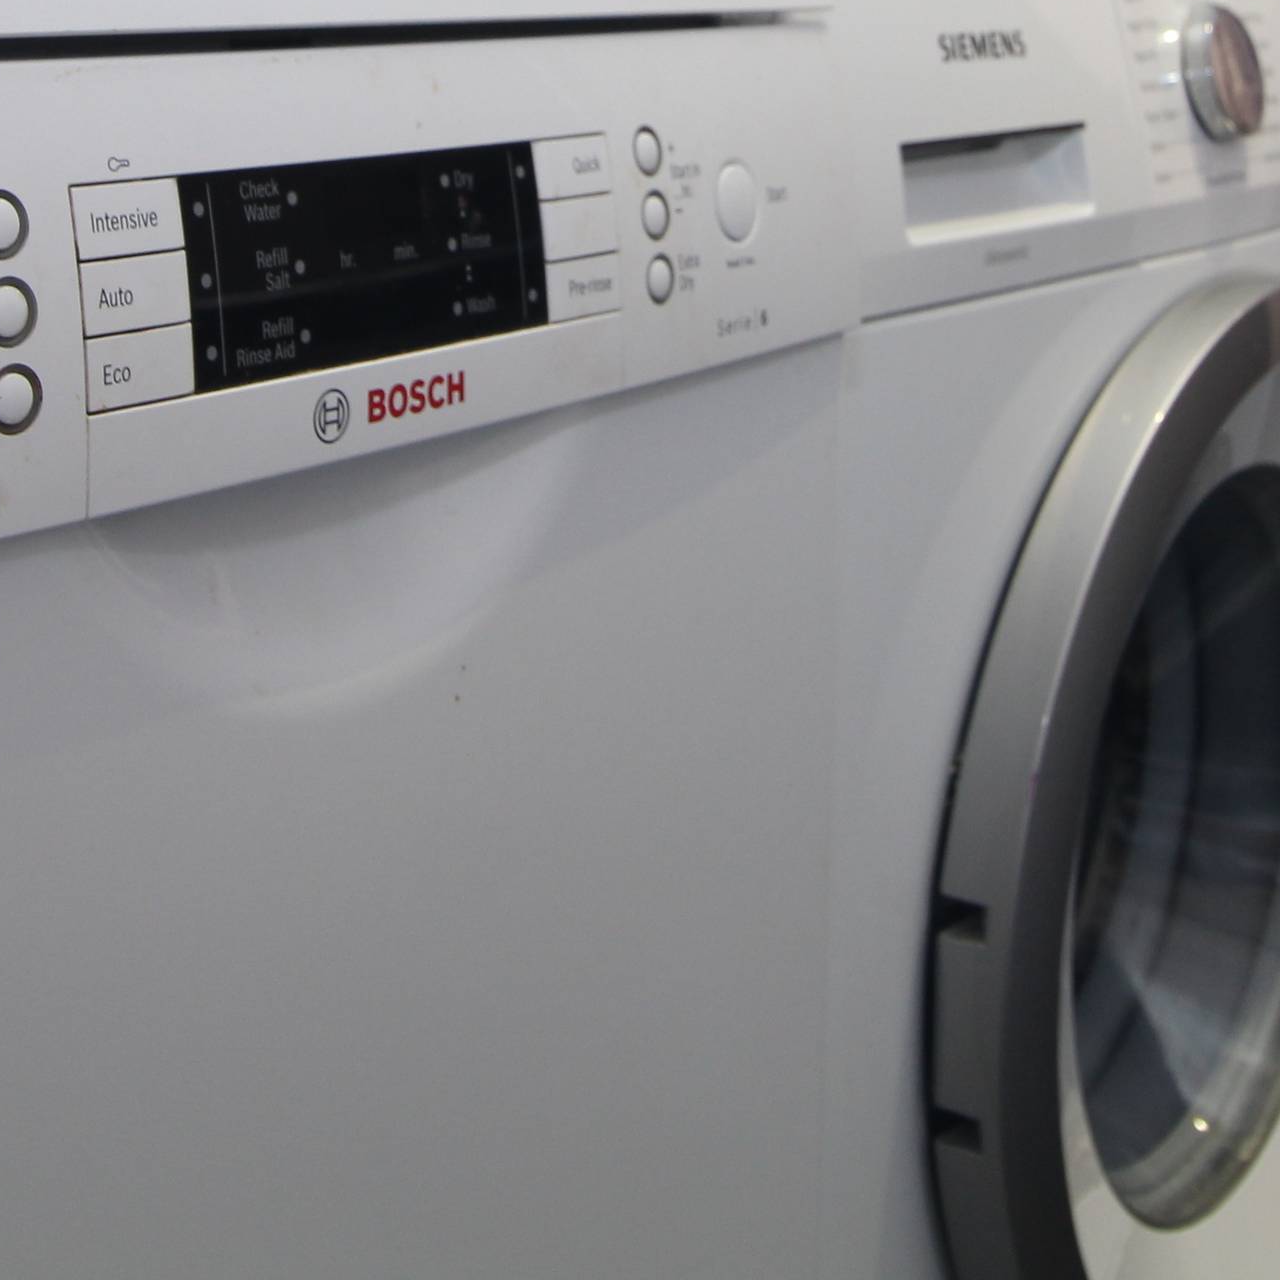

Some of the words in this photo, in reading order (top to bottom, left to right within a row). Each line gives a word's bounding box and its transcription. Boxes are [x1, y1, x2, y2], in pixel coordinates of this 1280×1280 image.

[938, 29, 1026, 62] SIEMENS
[572, 156, 601, 175] Quick
[239, 178, 280, 200] Check
[453, 170, 474, 192] Dry
[90, 208, 159, 234] Intensive
[244, 203, 282, 222] Water
[256, 247, 289, 269] Refill
[393, 241, 418, 261] min.
[265, 272, 291, 292] Salt
[98, 285, 135, 310] Auto
[465, 295, 496, 313] Wash
[262, 317, 295, 339] Refill
[236, 347, 272, 369] Rinse
[274, 340, 296, 361] Aid
[102, 363, 133, 387] Eco
[367, 371, 465, 424] BOSCH
